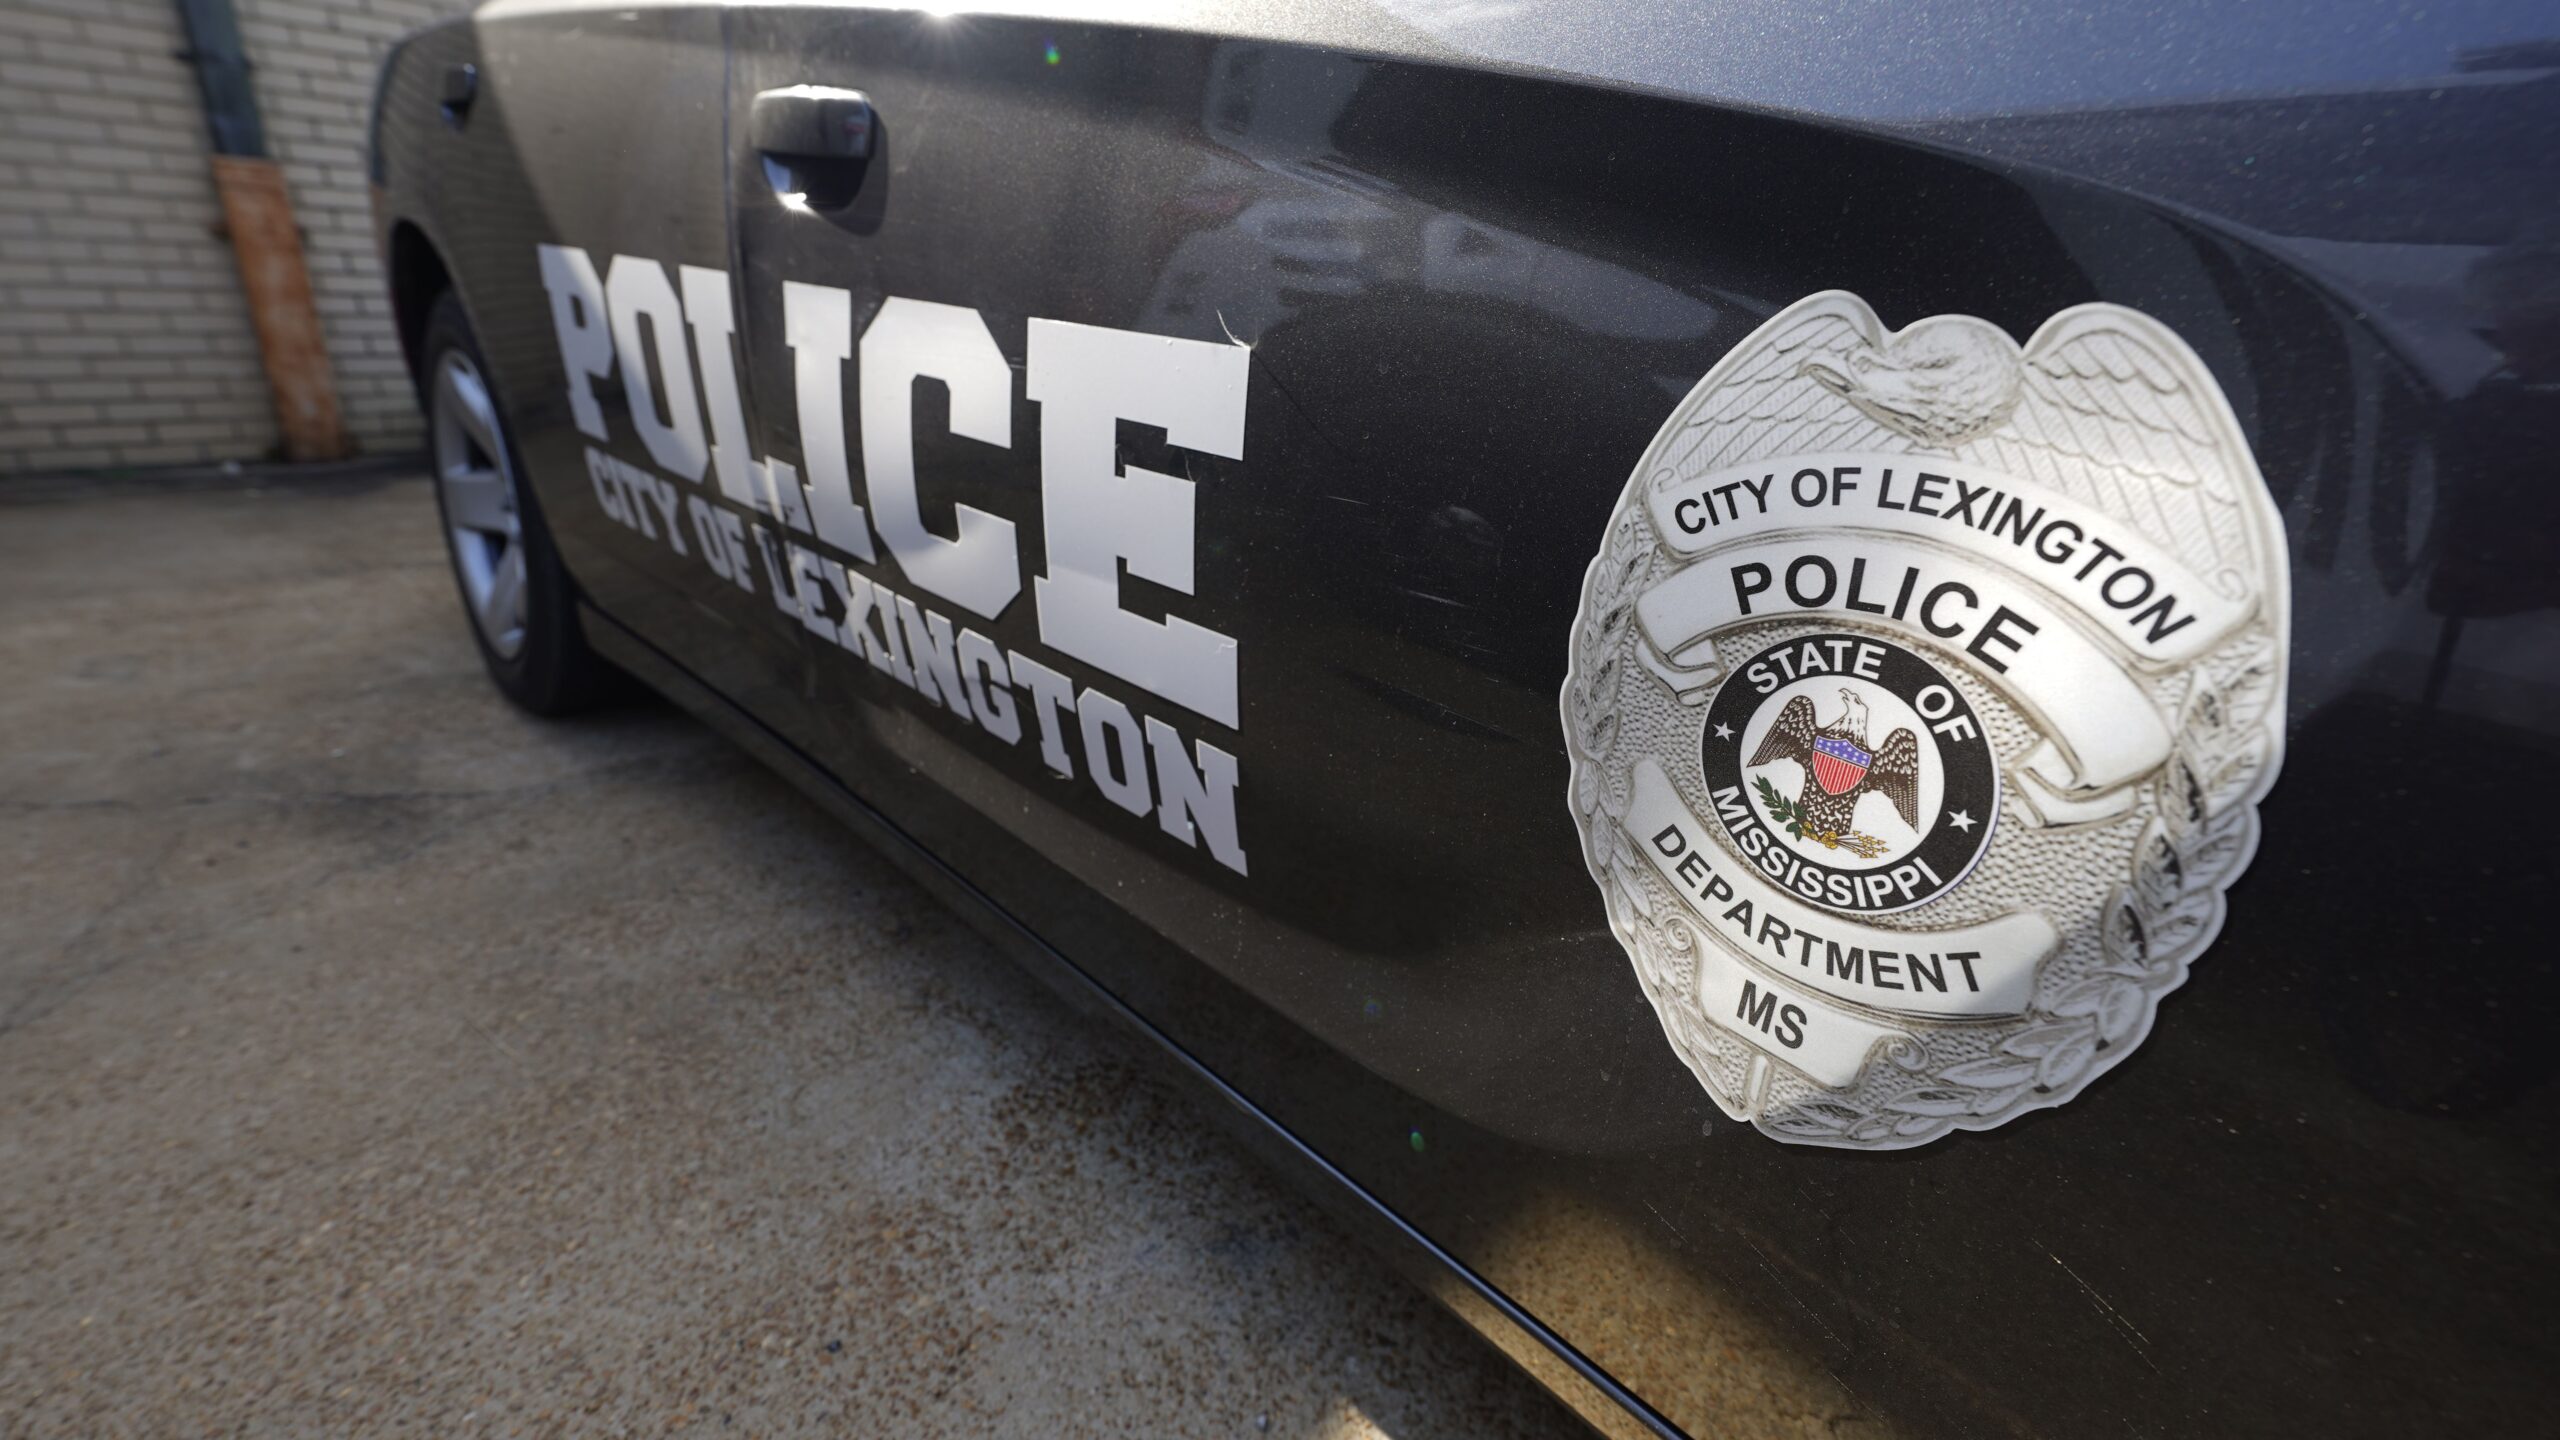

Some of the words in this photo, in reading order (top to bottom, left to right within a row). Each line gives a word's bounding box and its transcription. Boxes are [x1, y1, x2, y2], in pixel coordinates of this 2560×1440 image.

[537, 244, 1250, 730] POLICE
[1673, 474, 1774, 535] CITY
[1790, 467, 1861, 507] OF
[1878, 468, 2196, 645] LEXINGTON
[584, 446, 687, 556] CITY
[688, 495, 754, 593] OF
[752, 523, 1247, 877] LEXINGTON
[1730, 555, 2040, 674] POLICE
[1747, 640, 1886, 694] STATE
[1915, 684, 1979, 745] OF
[1652, 824, 1981, 993] DEPARTMENT
[1711, 785, 1943, 910] MISSISSIPPI
[1737, 980, 1808, 1050] MS
